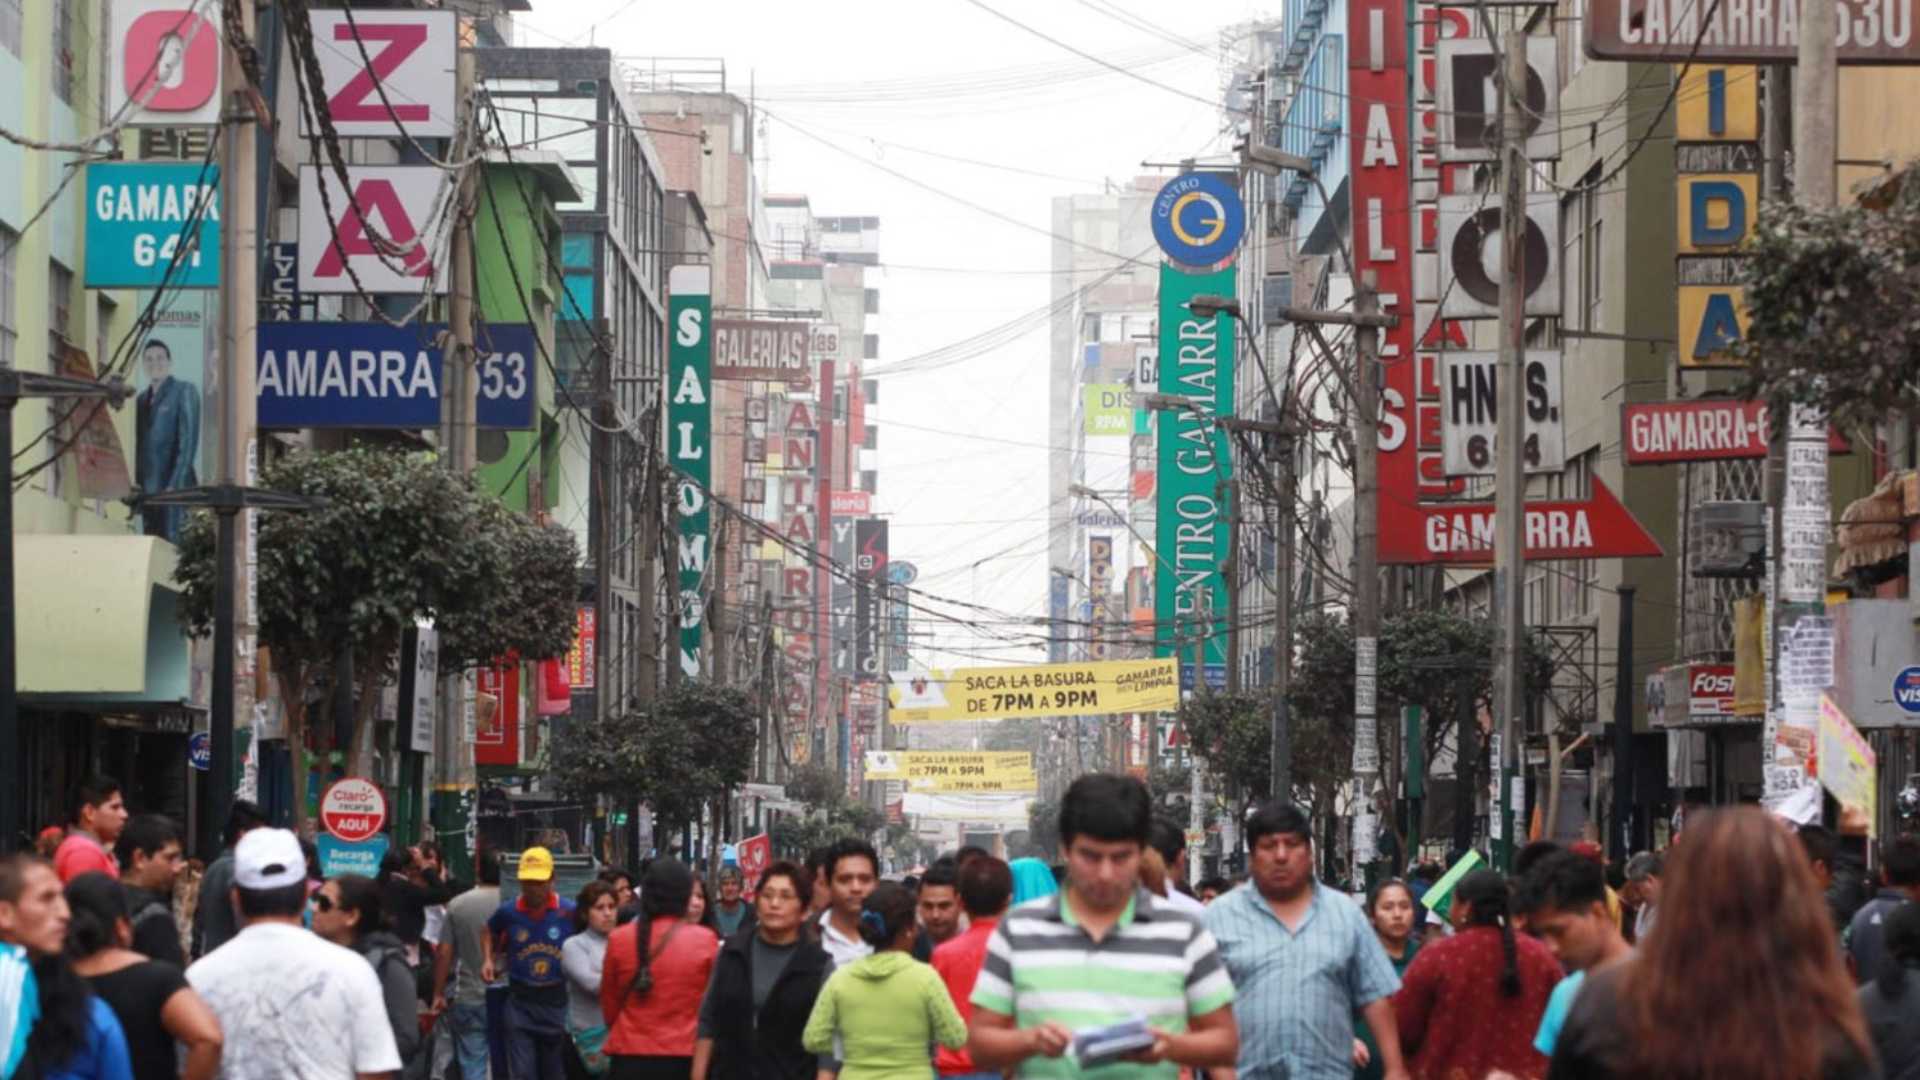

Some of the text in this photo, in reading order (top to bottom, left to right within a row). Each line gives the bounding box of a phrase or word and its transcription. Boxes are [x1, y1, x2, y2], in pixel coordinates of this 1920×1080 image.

[1157, 177, 1200, 219] CENTRO
[715, 328, 803, 370] GALERIAS
[473, 352, 527, 400] 53
[1175, 300, 1219, 476] GAMARR
[1450, 360, 1559, 425] HNS.
[1467, 432, 1542, 469] 64
[674, 308, 707, 677] SALOMON
[1426, 510, 1593, 554] GAMRRA
[966, 671, 1096, 691] SACA LA BASURA
[1115, 664, 1173, 685] GAMARRA
[1134, 676, 1174, 693] LIMPIA
[967, 690, 1098, 713] DE 7PM A 9PM
[924, 765, 949, 776] 7PM
[959, 765, 984, 776] 9PM
[333, 790, 368, 801] Claro
